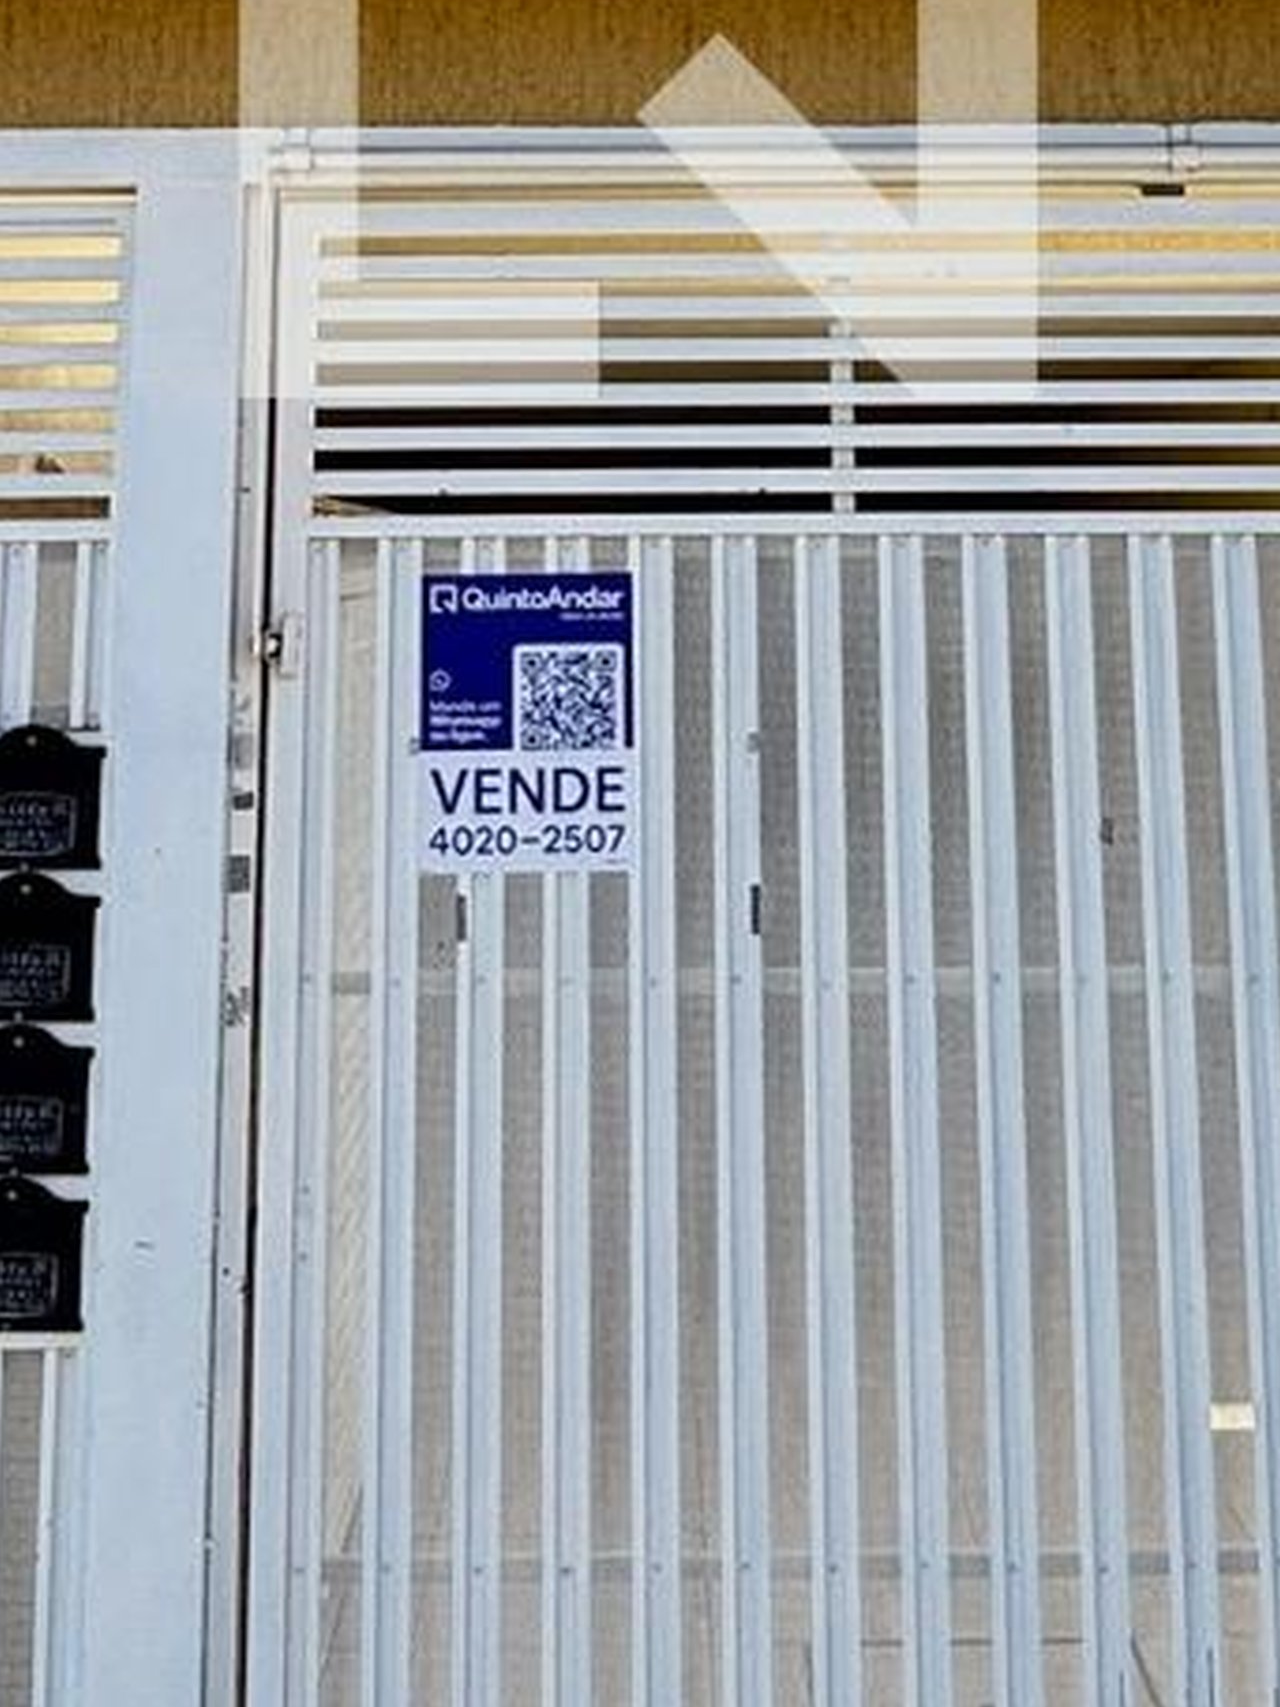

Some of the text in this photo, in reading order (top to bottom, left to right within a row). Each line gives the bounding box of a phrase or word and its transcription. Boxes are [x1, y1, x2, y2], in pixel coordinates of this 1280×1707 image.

[462, 584, 625, 610] QuintoAndar
[429, 766, 626, 815] VENDE
[428, 824, 626, 856] 4020-2507
